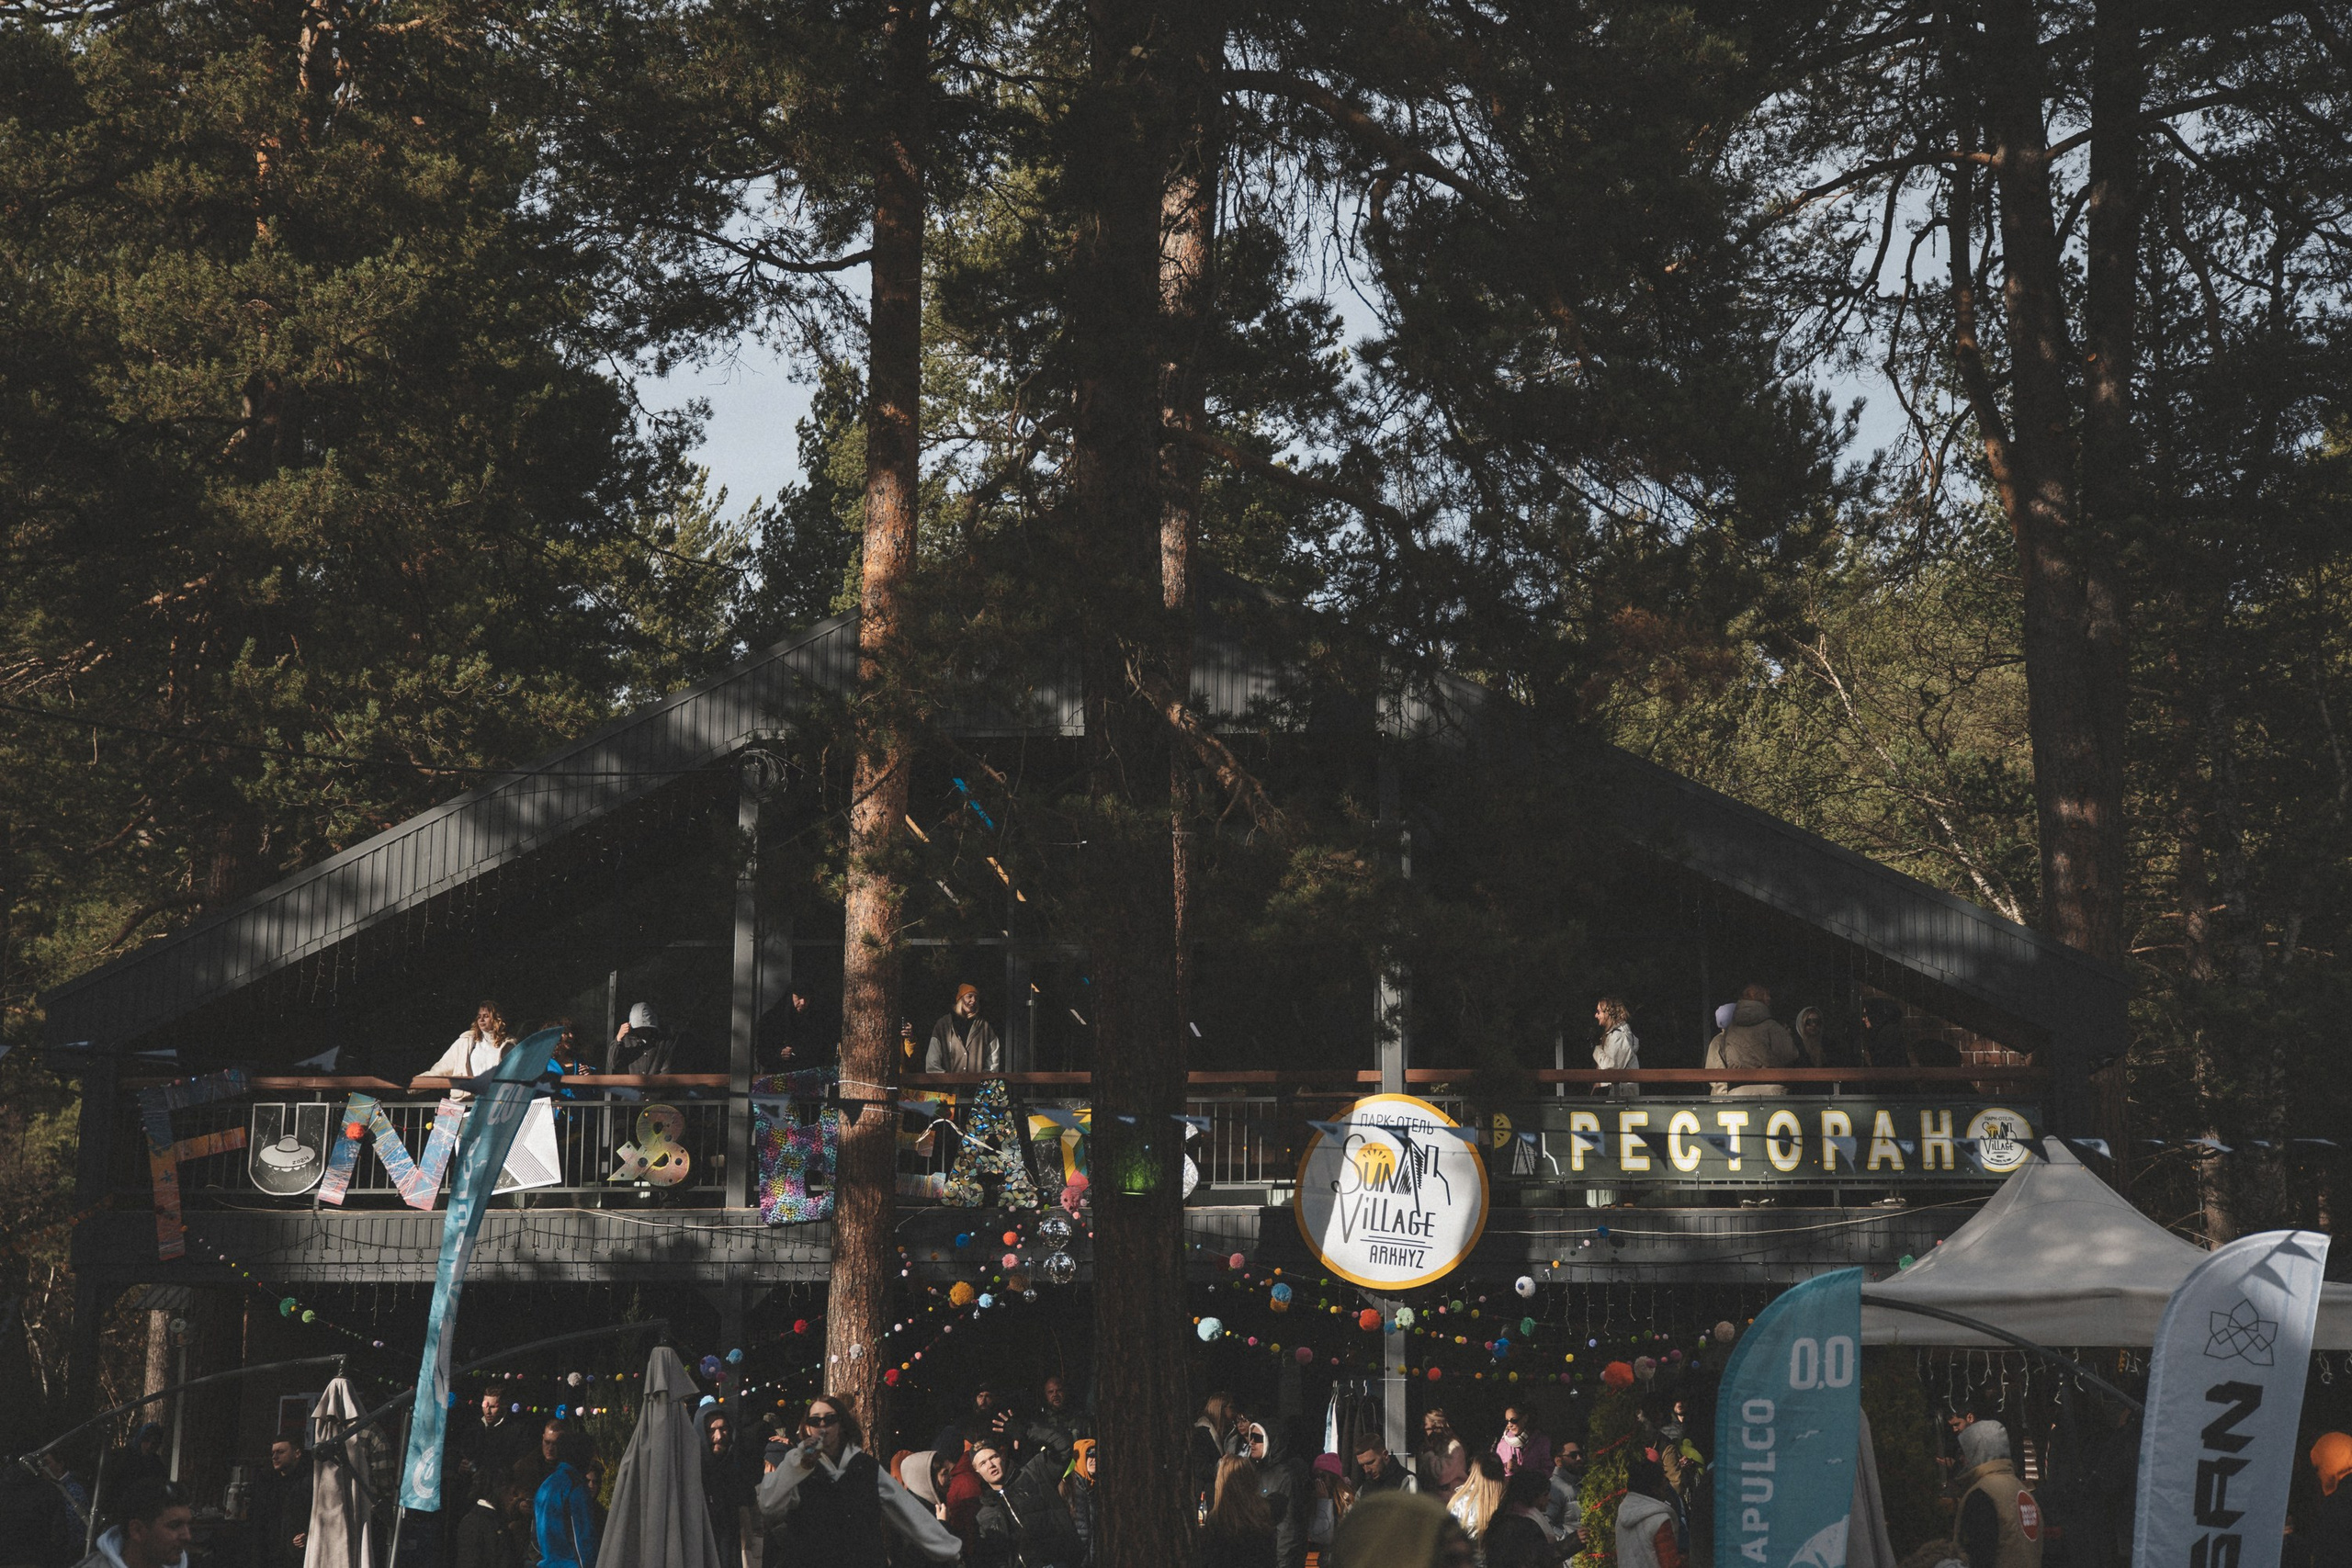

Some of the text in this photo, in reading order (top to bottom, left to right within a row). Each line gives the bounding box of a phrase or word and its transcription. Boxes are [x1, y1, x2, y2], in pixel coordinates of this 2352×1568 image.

[1360, 1113, 1434, 1135] ПАРК-ОТЕЛЬ
[751, 1065, 1198, 1225] BEAT
[1570, 1110, 1955, 1171] РЕСТОРАН
[292, 1156, 310, 1165] 2024
[1369, 1245, 1425, 1269] ARKHYZ
